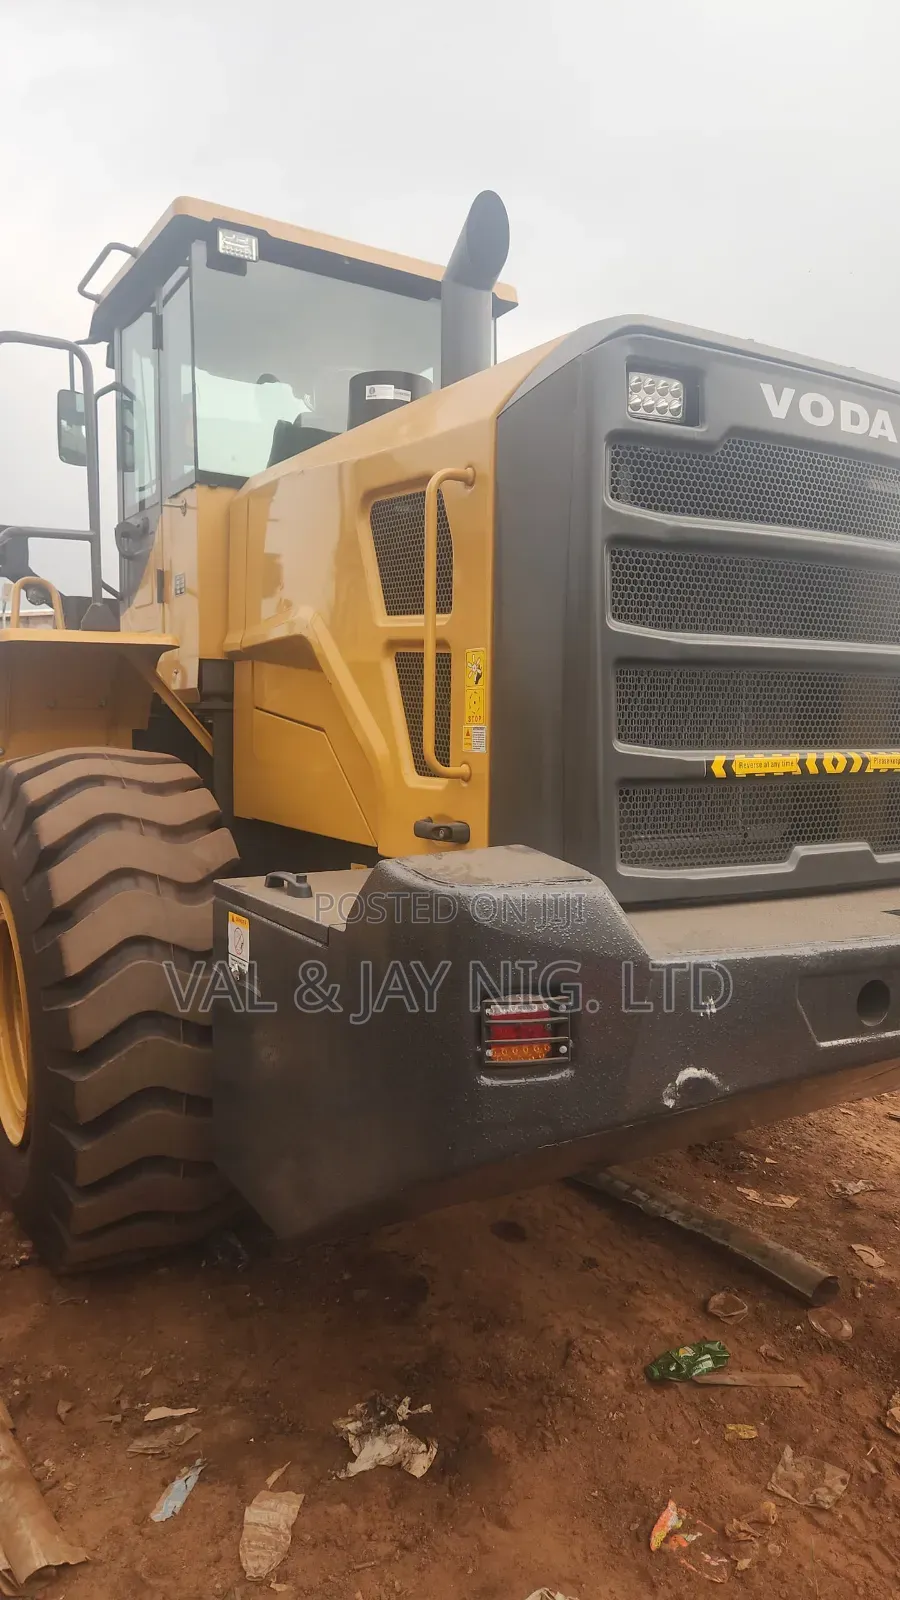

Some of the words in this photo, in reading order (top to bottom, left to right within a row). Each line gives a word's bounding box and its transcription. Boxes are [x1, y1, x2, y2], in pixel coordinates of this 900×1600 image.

[760, 383, 898, 443] VODA
[739, 761, 763, 769] Reverse
[770, 761, 781, 769] any
[781, 759, 794, 767] time
